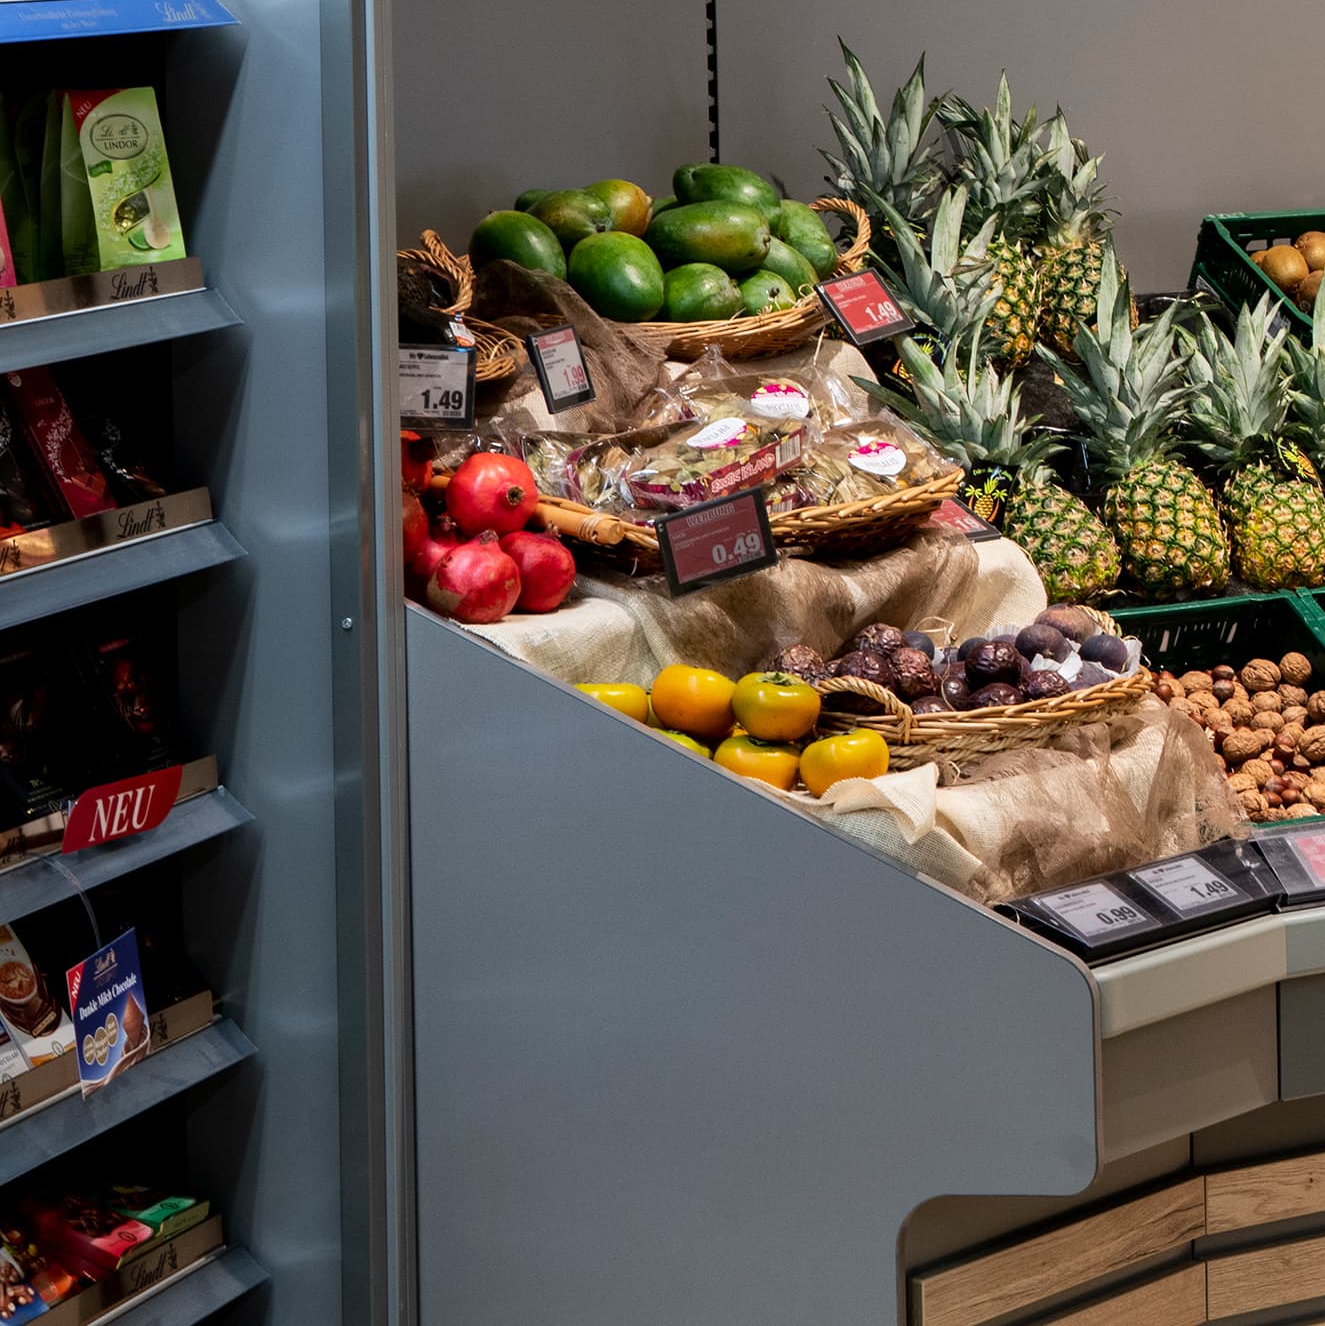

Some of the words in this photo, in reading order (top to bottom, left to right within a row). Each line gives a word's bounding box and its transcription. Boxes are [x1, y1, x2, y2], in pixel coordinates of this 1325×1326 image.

[155, 1, 195, 23] Lindt
[76, 100, 92, 119] NEU
[100, 122, 129, 138] Lidt
[104, 139, 139, 151] LINDOR
[110, 271, 148, 300] Lindt
[865, 301, 897, 323] 1.49
[563, 365, 587, 387] 1.99
[421, 389, 464, 410] 1.49
[116, 508, 154, 538] Lindt
[685, 503, 736, 527] WERBUNG
[712, 532, 760, 564] 0.49
[88, 784, 156, 843] NEU
[1190, 880, 1229, 899] 1.49
[1096, 905, 1138, 925] 0.99
[71, 970, 82, 999] NEU
[78, 998, 98, 1021] Dunkle
[97, 988, 112, 1008] Milch
